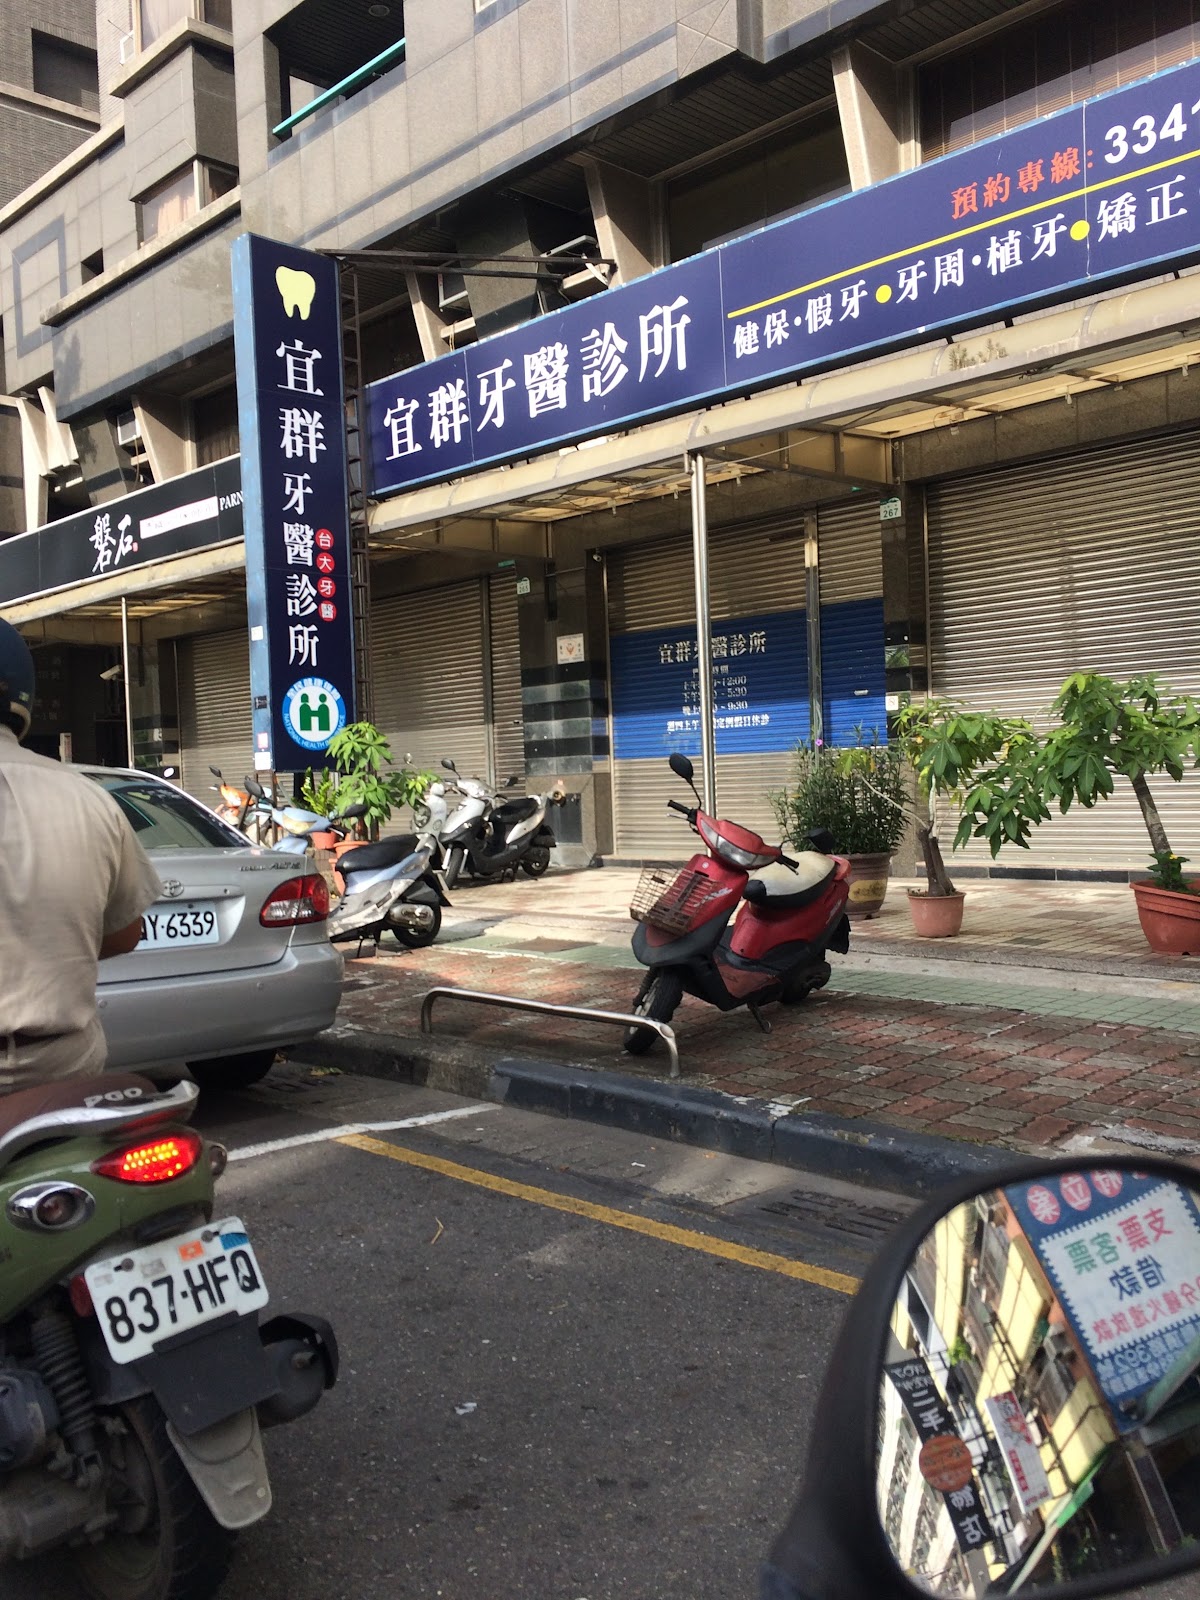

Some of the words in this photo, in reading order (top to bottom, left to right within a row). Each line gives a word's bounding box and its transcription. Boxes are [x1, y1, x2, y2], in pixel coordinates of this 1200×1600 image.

[1104, 98, 1200, 164] 334
[383, 295, 691, 461] 宜群牙醫診所
[276, 339, 327, 667] 宜群牙醫診所
[883, 508, 899, 518] 267
[318, 531, 335, 619] 台大牙醫
[84, 1087, 143, 1108] PGO
[105, 1250, 260, 1343] 837-HFQ
